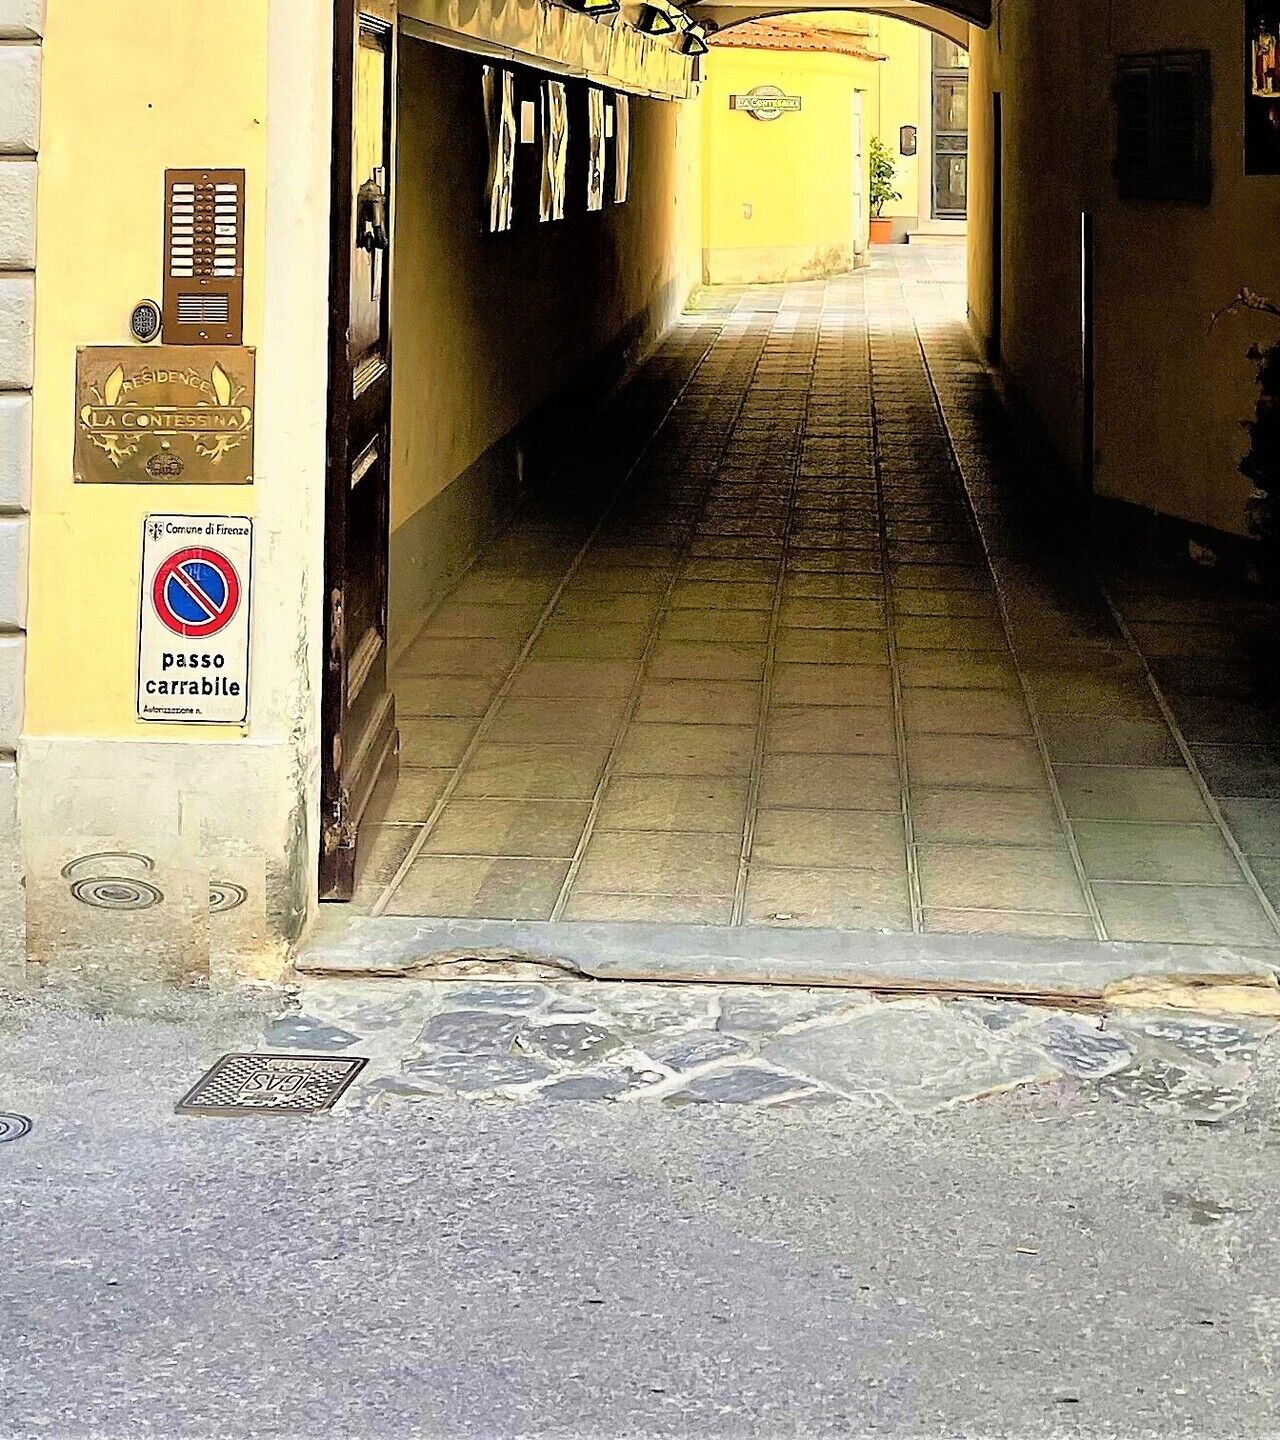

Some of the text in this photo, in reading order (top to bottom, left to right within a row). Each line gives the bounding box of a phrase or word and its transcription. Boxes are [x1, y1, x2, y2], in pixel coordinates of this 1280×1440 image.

[121, 369, 213, 394] RESIDENCE
[92, 412, 116, 427] LA
[166, 522, 203, 535] Comune
[205, 522, 214, 535] di
[162, 652, 225, 671] passo
[145, 676, 240, 696] carrabile
[243, 1072, 304, 1093] GAS
